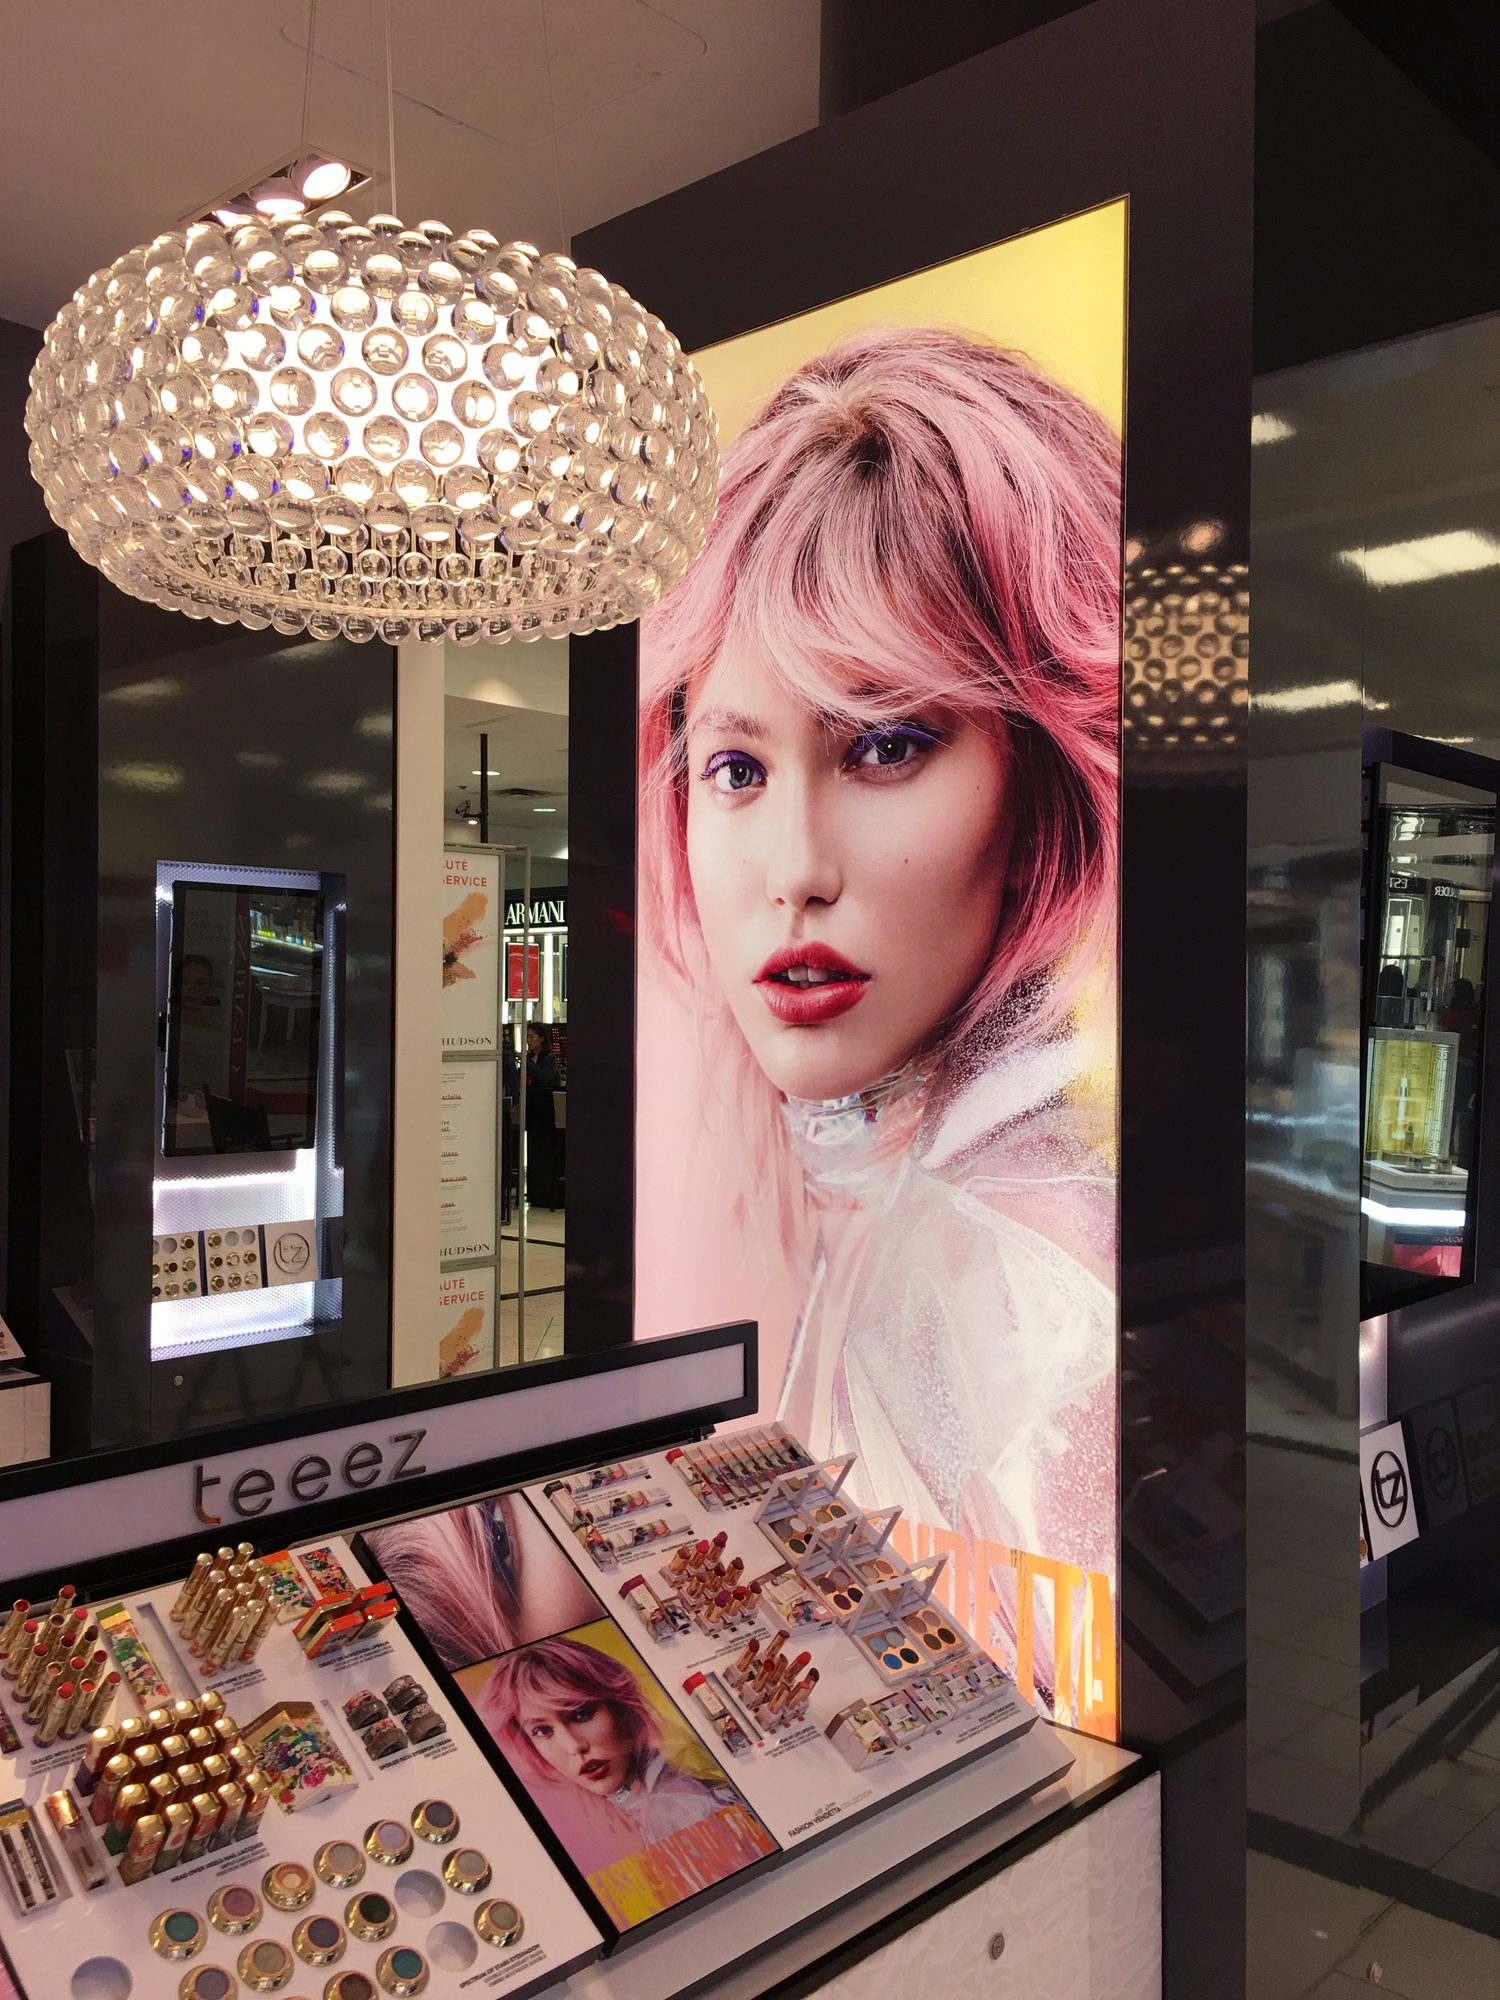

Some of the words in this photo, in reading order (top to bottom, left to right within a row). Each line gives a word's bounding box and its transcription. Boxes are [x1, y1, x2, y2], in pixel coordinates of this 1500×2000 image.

[443, 859, 468, 870] UTÉ
[443, 875, 487, 887] ERVICE
[505, 901, 565, 925] ARMANI
[442, 1037, 492, 1046] HUDSON
[440, 1243, 490, 1256] HUDSON
[193, 1427, 427, 1525] teeez
[787, 1819, 814, 1838] FASHION
[812, 1805, 842, 1825] VENDETTA
